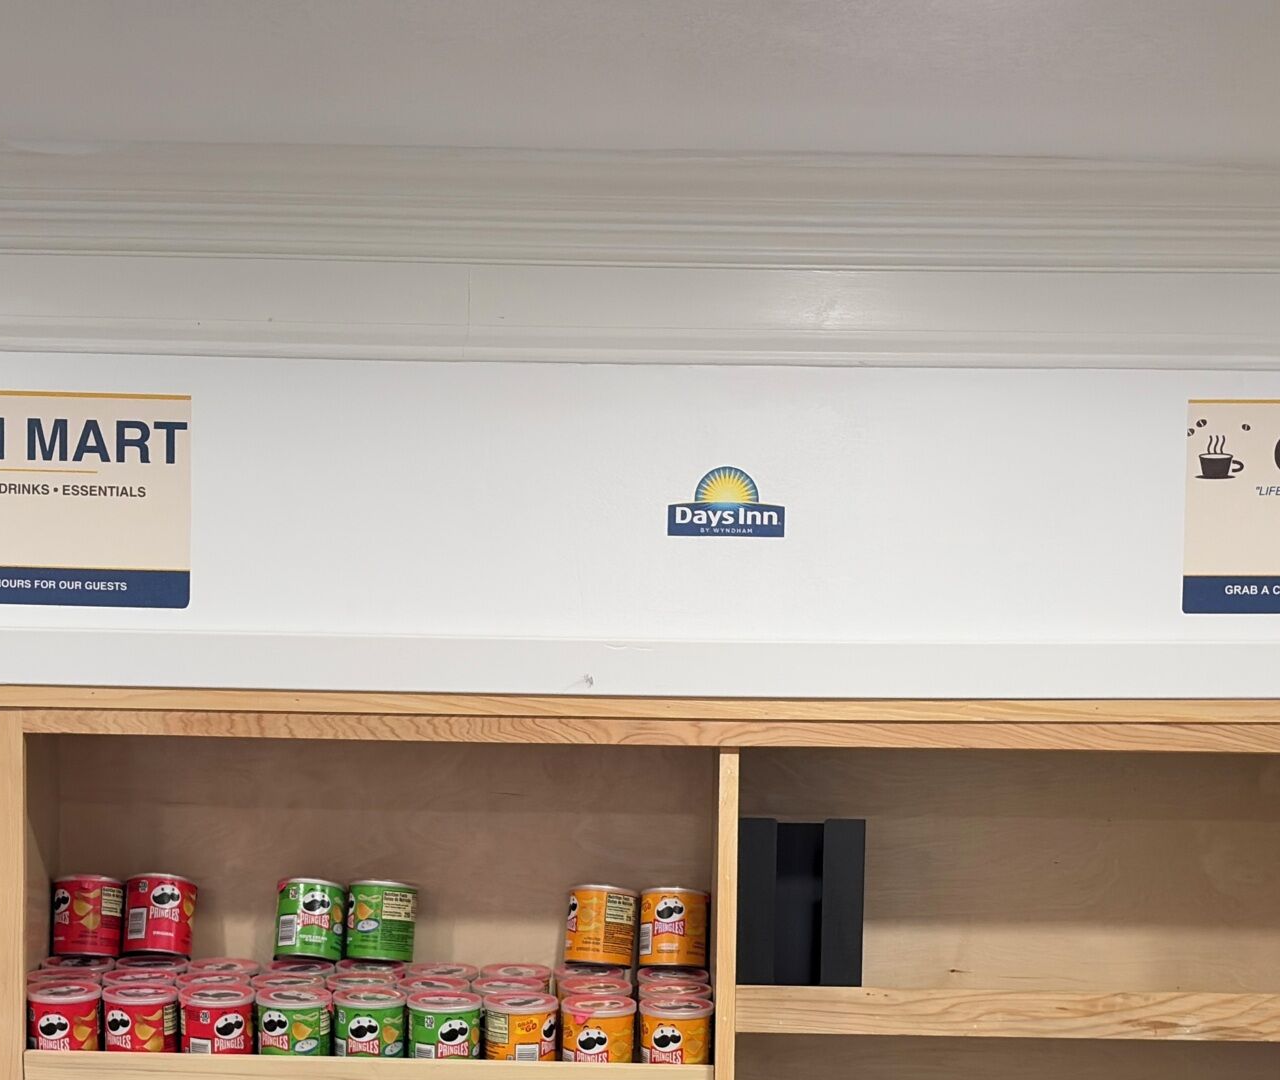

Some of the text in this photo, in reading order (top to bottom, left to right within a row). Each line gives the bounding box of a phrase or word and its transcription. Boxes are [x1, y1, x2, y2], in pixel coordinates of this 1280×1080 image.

[26, 418, 188, 464] MART
[62, 484, 147, 498] ESSENTIALS
[675, 506, 778, 527] Days Inn
[34, 579, 57, 590] FOR
[58, 580, 82, 590] OUR
[84, 581, 128, 591] GUESTS
[1224, 585, 1258, 596] GRAB
[1260, 585, 1269, 596] A
[150, 906, 180, 922] PRINGLES
[300, 913, 330, 930] PRINGLES
[654, 920, 684, 936] PRINGLES
[39, 1036, 70, 1050] PRINGLES
[214, 1036, 244, 1052] PRINGLES
[262, 1034, 288, 1050] PRINGLES
[348, 1040, 379, 1054] PRINGLES
[438, 1042, 468, 1057] PRINGLES
[651, 1050, 682, 1064] PRINGLES
